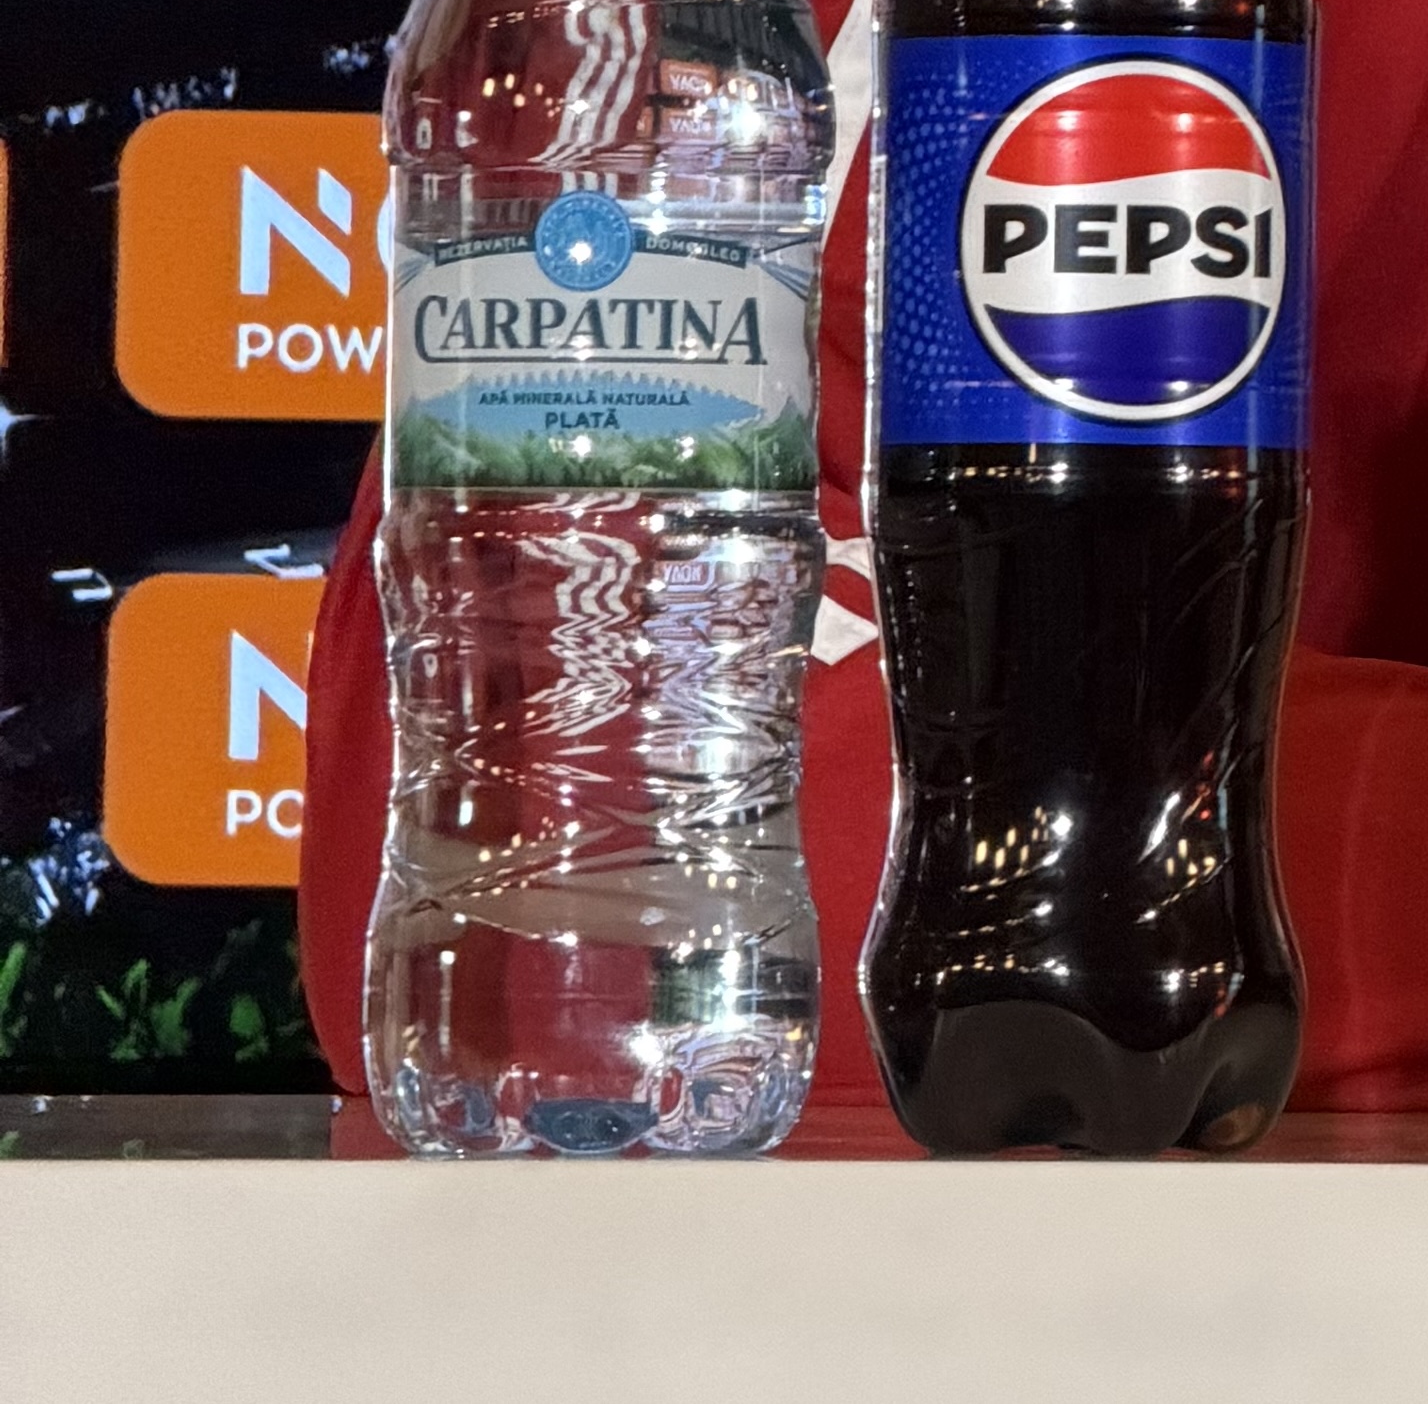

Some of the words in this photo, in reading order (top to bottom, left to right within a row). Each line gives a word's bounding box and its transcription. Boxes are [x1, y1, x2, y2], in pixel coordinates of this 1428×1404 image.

[982, 202, 1274, 280] PEPSI
[238, 322, 383, 373] POW
[413, 294, 769, 366] CARPATINA
[544, 407, 620, 430] PLATĂ
